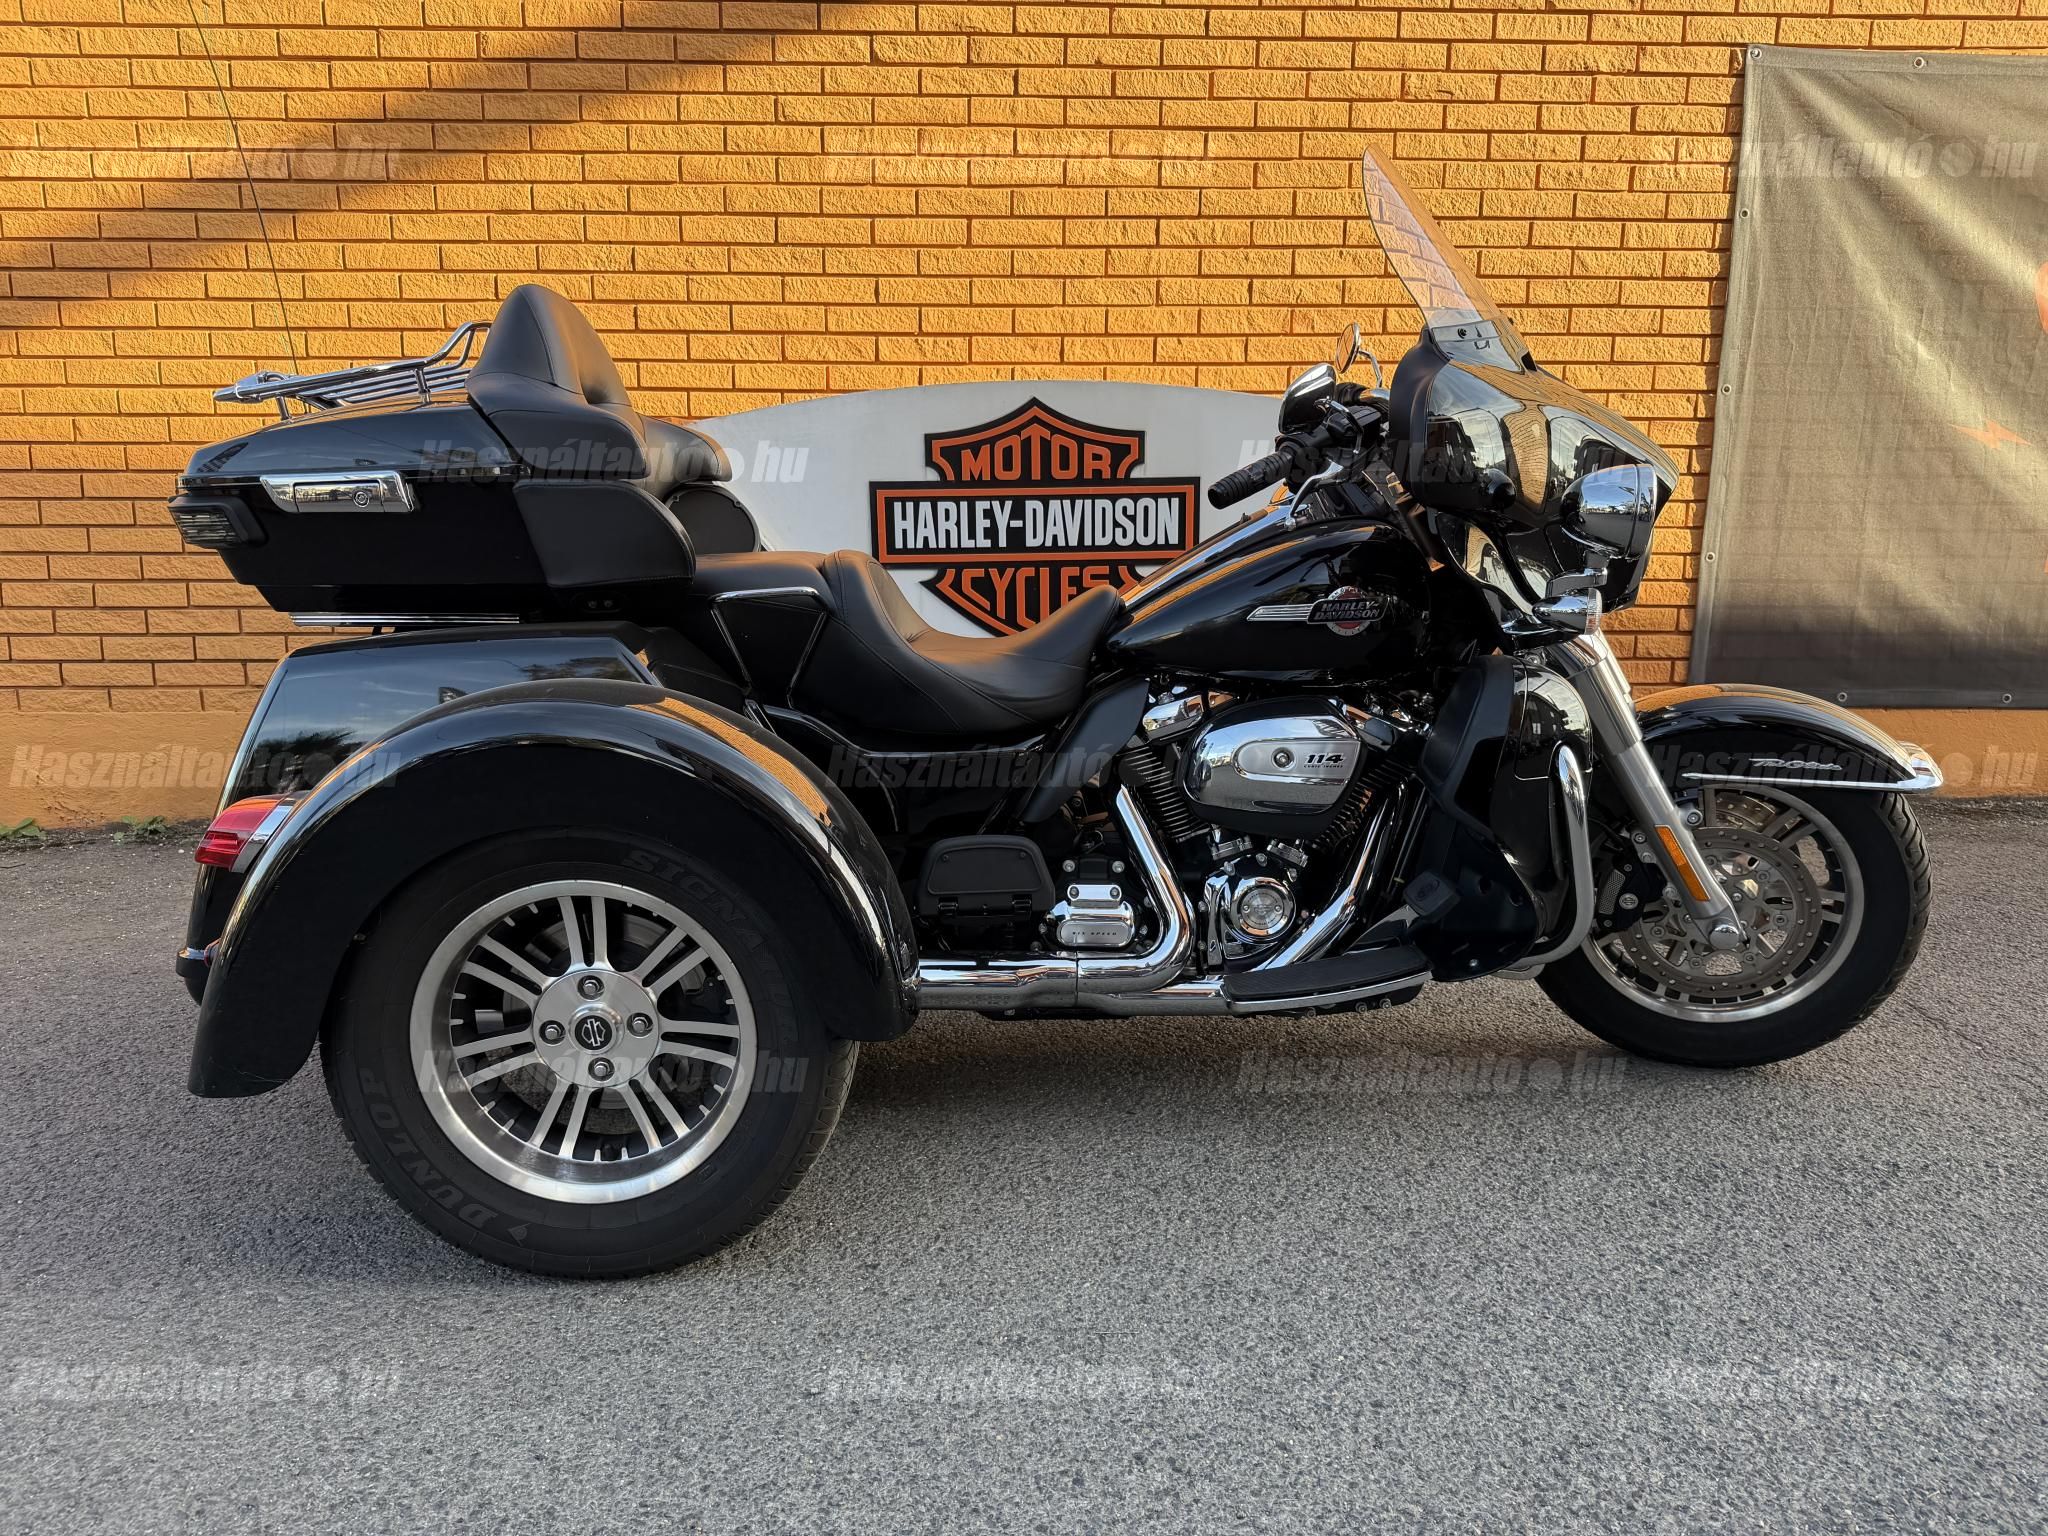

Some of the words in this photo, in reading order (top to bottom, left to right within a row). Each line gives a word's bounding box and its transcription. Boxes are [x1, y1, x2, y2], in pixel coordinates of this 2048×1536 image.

[961, 423, 1111, 480] MOTOR
[893, 497, 1179, 549] HARLEY-DAVIDSON
[1314, 609, 1380, 621] DAVIDSON
[1307, 754, 1344, 764] 114
[358, 1066, 499, 1230] DUNLOP
